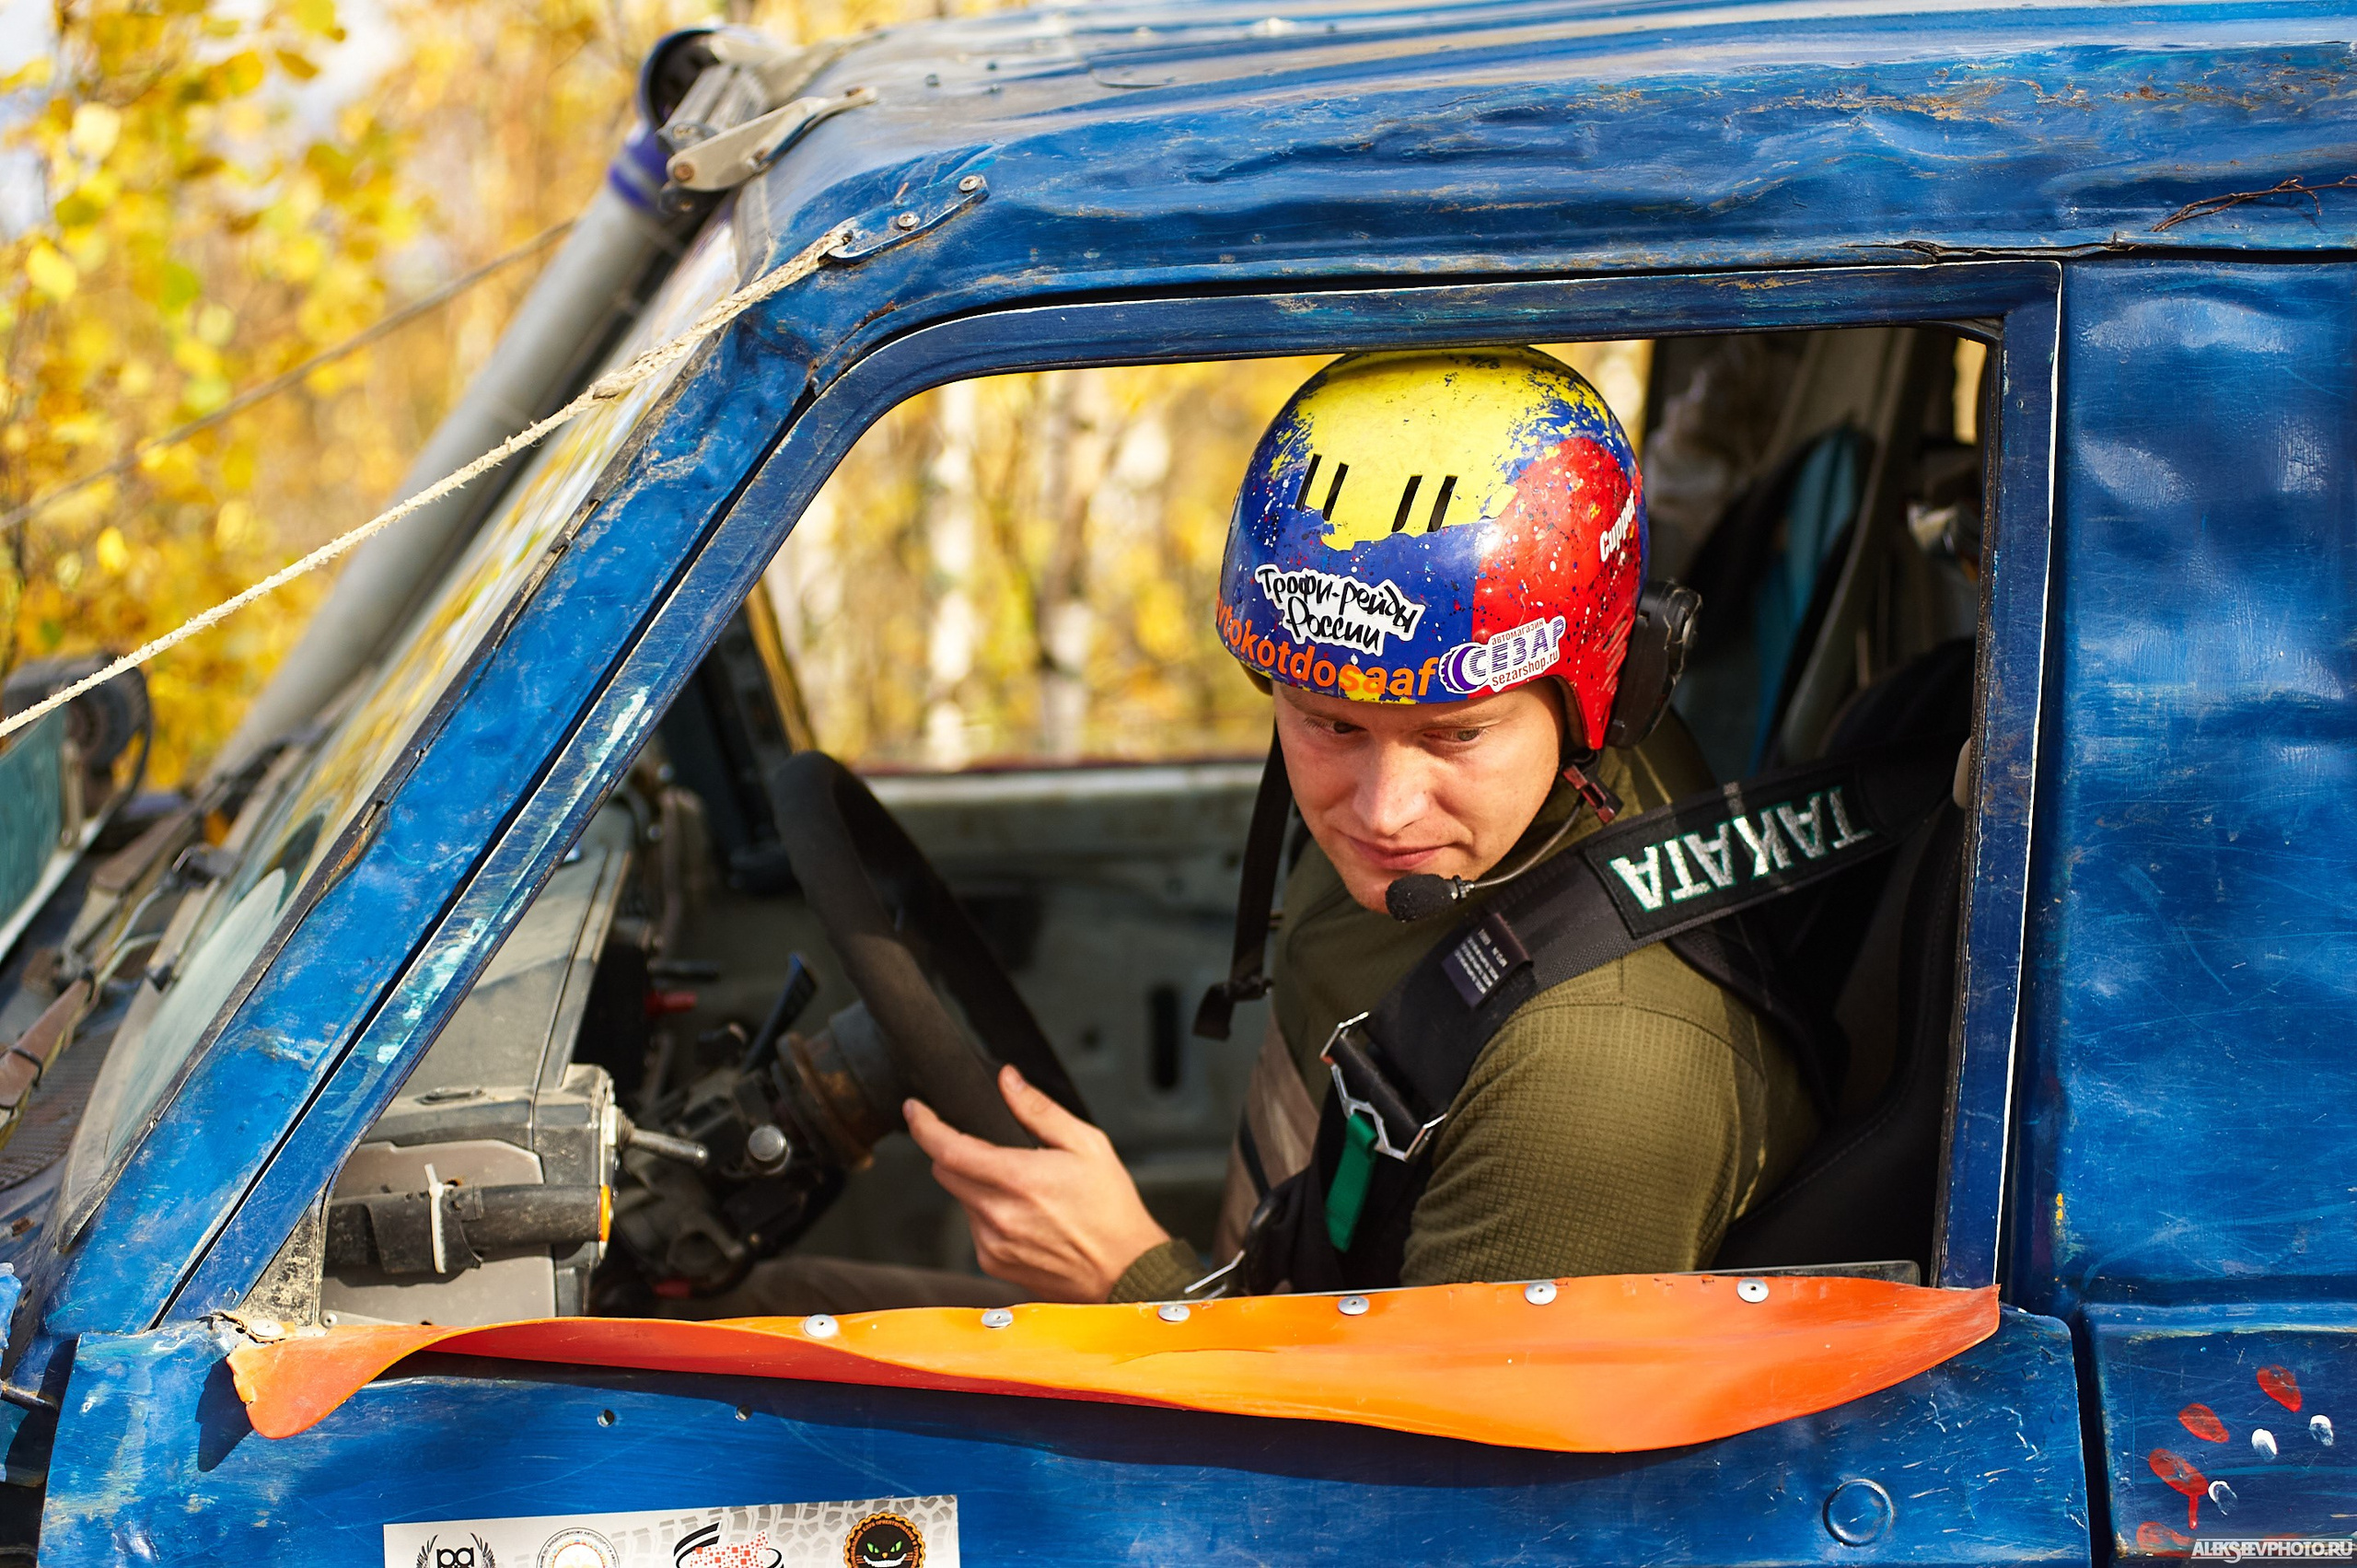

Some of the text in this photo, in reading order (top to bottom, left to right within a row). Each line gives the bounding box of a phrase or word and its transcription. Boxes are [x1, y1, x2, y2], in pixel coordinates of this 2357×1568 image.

[1257, 568, 1418, 633] Трофи-рейды
[1285, 596, 1380, 650] России
[1215, 584, 1439, 696] vtokotdosaaf
[1469, 619, 1564, 678] СЕЗАР
[1492, 620, 1544, 645] автомагазин
[1492, 650, 1559, 687] sezarshop.ru
[1607, 785, 1874, 912] TAKATA
